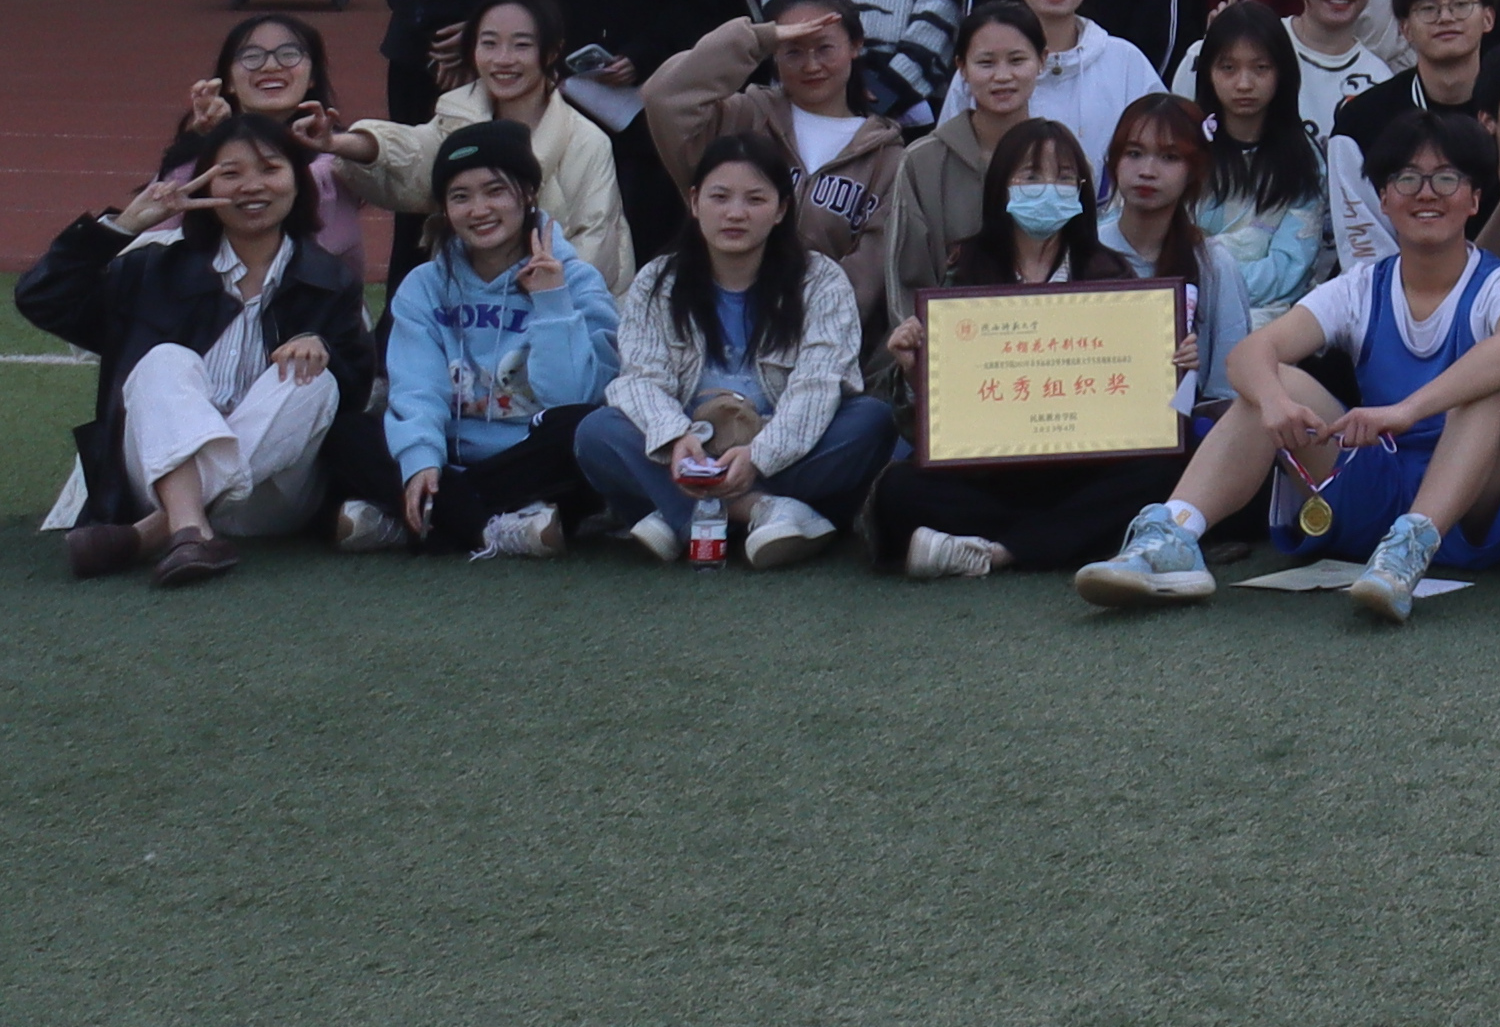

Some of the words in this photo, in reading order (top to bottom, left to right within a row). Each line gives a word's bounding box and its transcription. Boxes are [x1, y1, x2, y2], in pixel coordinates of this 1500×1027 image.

[977, 373, 1130, 402] 优秀组织奖
